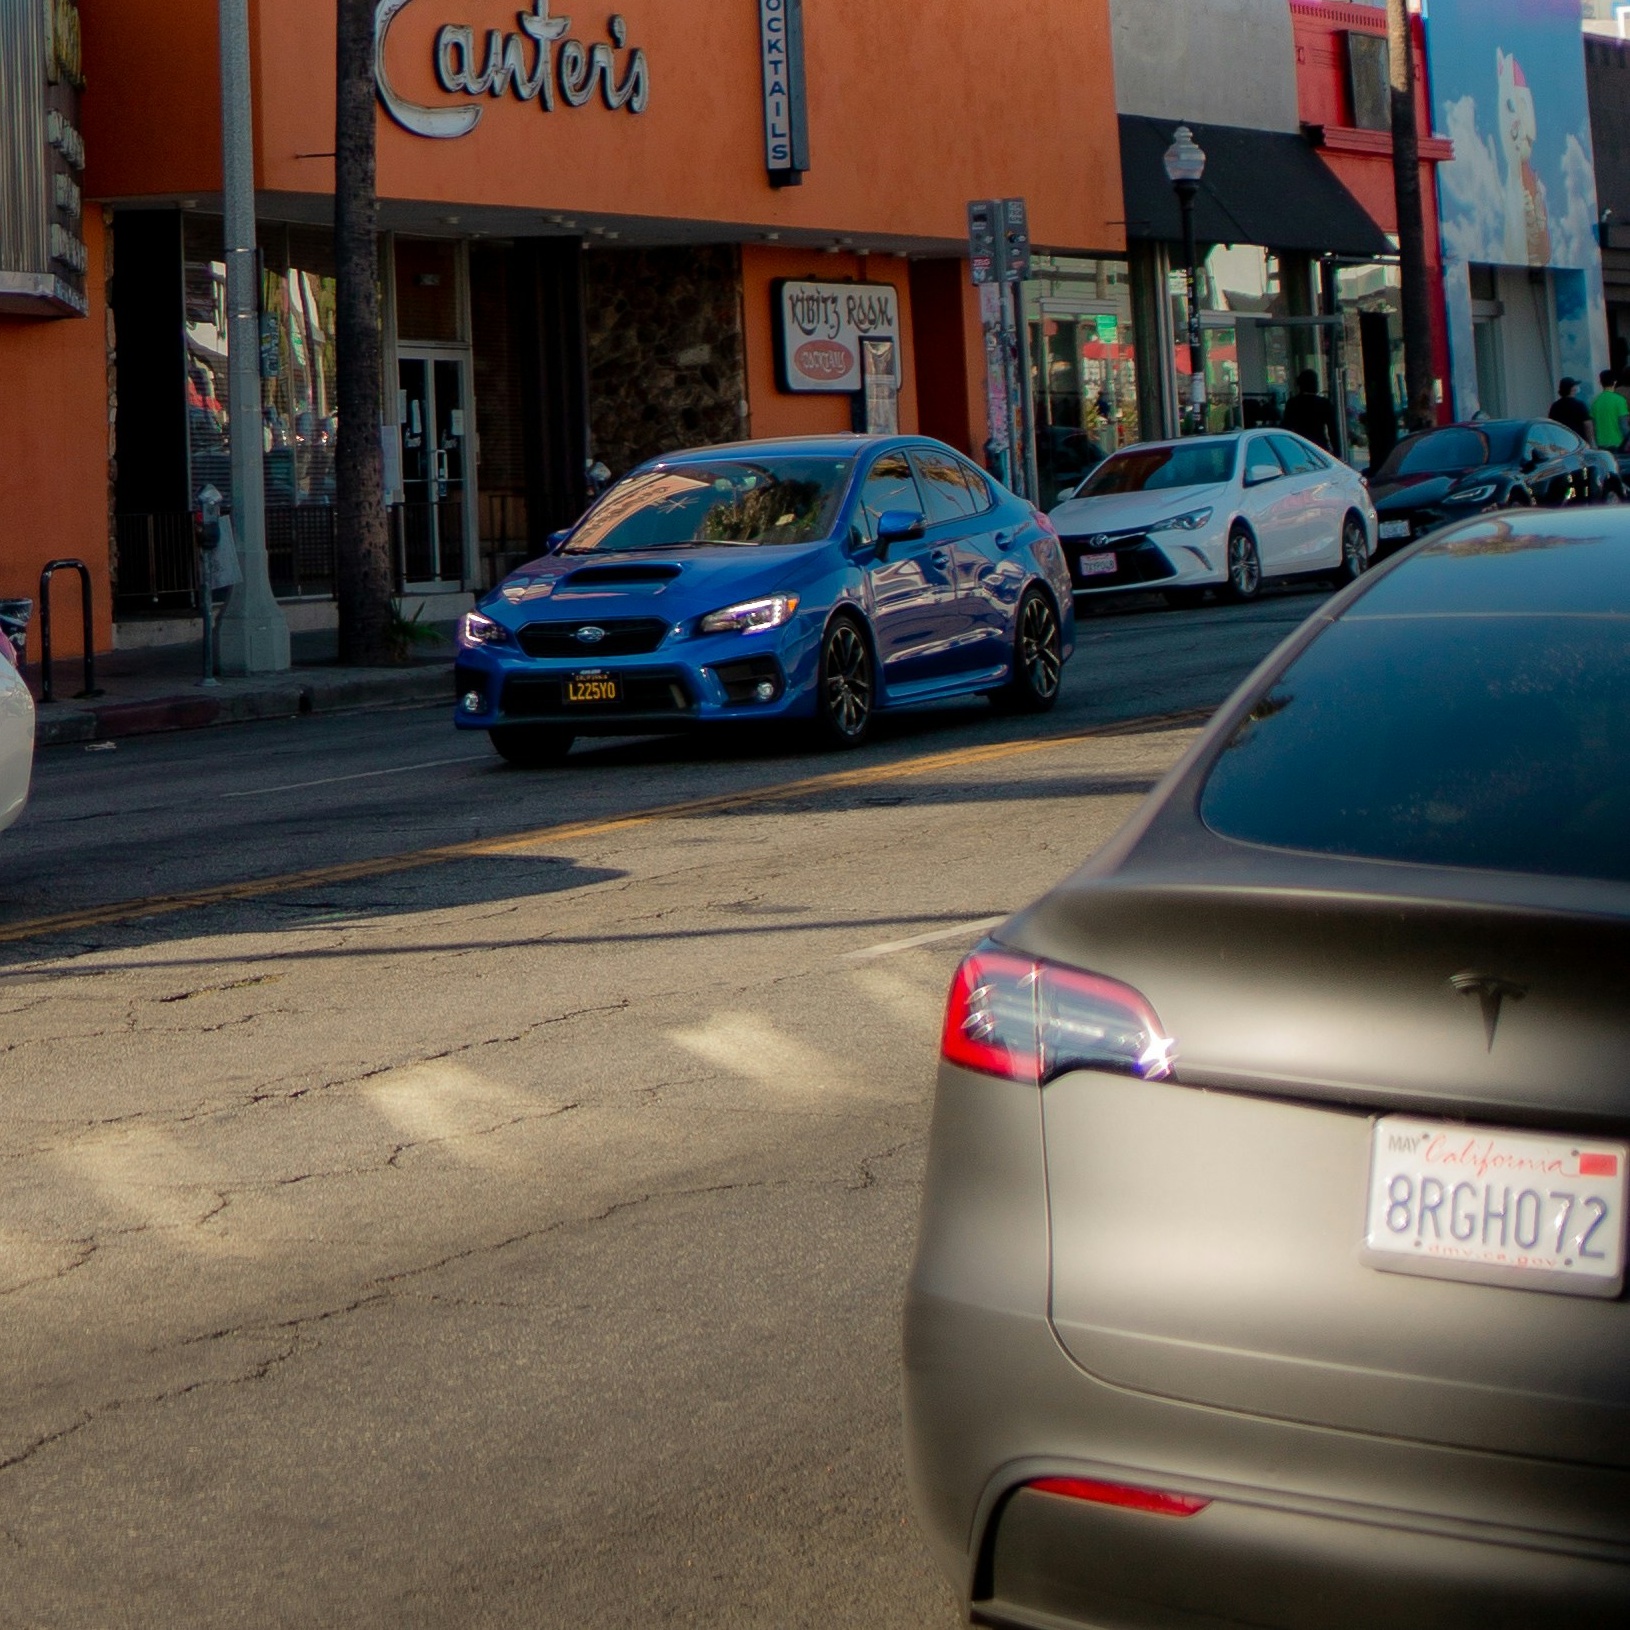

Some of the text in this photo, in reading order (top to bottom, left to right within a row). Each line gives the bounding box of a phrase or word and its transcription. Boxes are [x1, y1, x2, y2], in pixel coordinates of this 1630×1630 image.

[846, 294, 894, 334] ROOM
[1388, 1134, 1580, 1178] MAY California
[1385, 1173, 1609, 1261] 8RGH072
[1427, 1243, 1558, 1269] dmv.ca.gov
